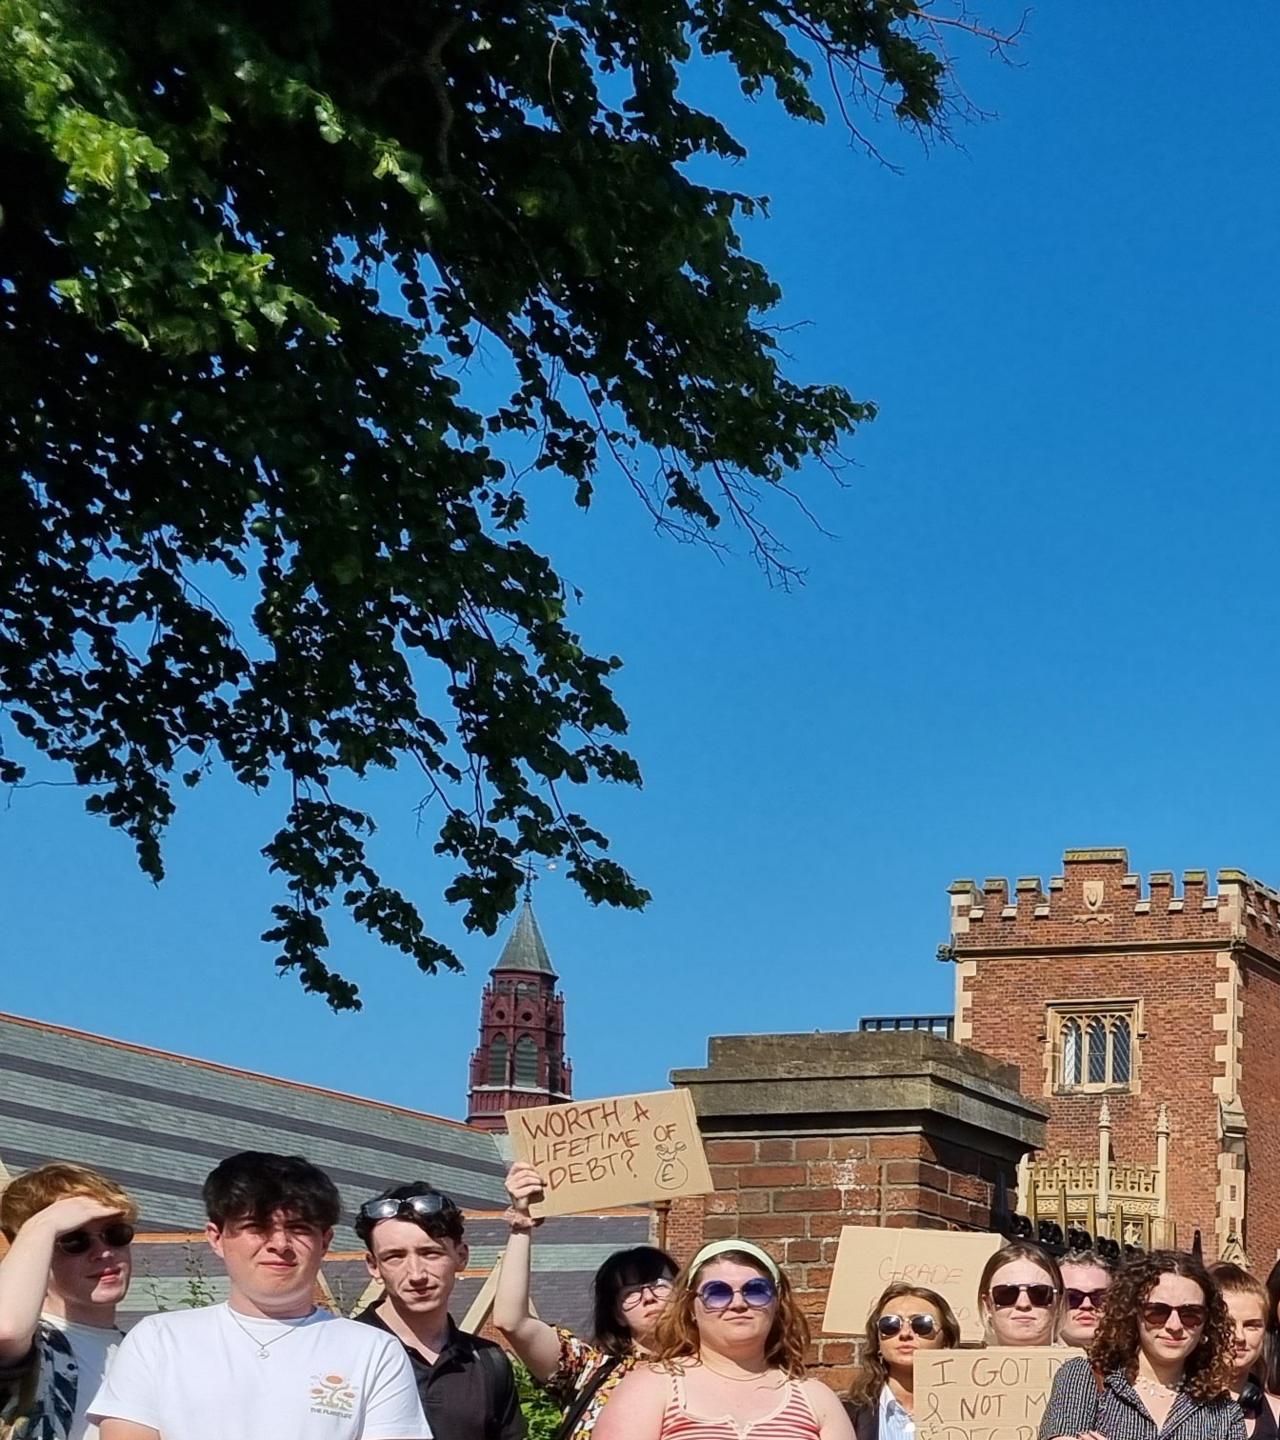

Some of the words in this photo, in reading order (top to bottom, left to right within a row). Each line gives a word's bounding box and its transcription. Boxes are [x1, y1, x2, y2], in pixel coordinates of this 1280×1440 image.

[522, 1100, 622, 1139] WORTH
[632, 1100, 650, 1123] A
[532, 1129, 640, 1167] LIFETIME
[653, 1123, 677, 1142] OF
[549, 1150, 638, 1191] DEBT?
[878, 1256, 964, 1285] GRADE
[931, 1359, 957, 1387] I
[971, 1358, 1033, 1387] GOT
[960, 1393, 1007, 1421] NOT
[1026, 1392, 1047, 1418] M
